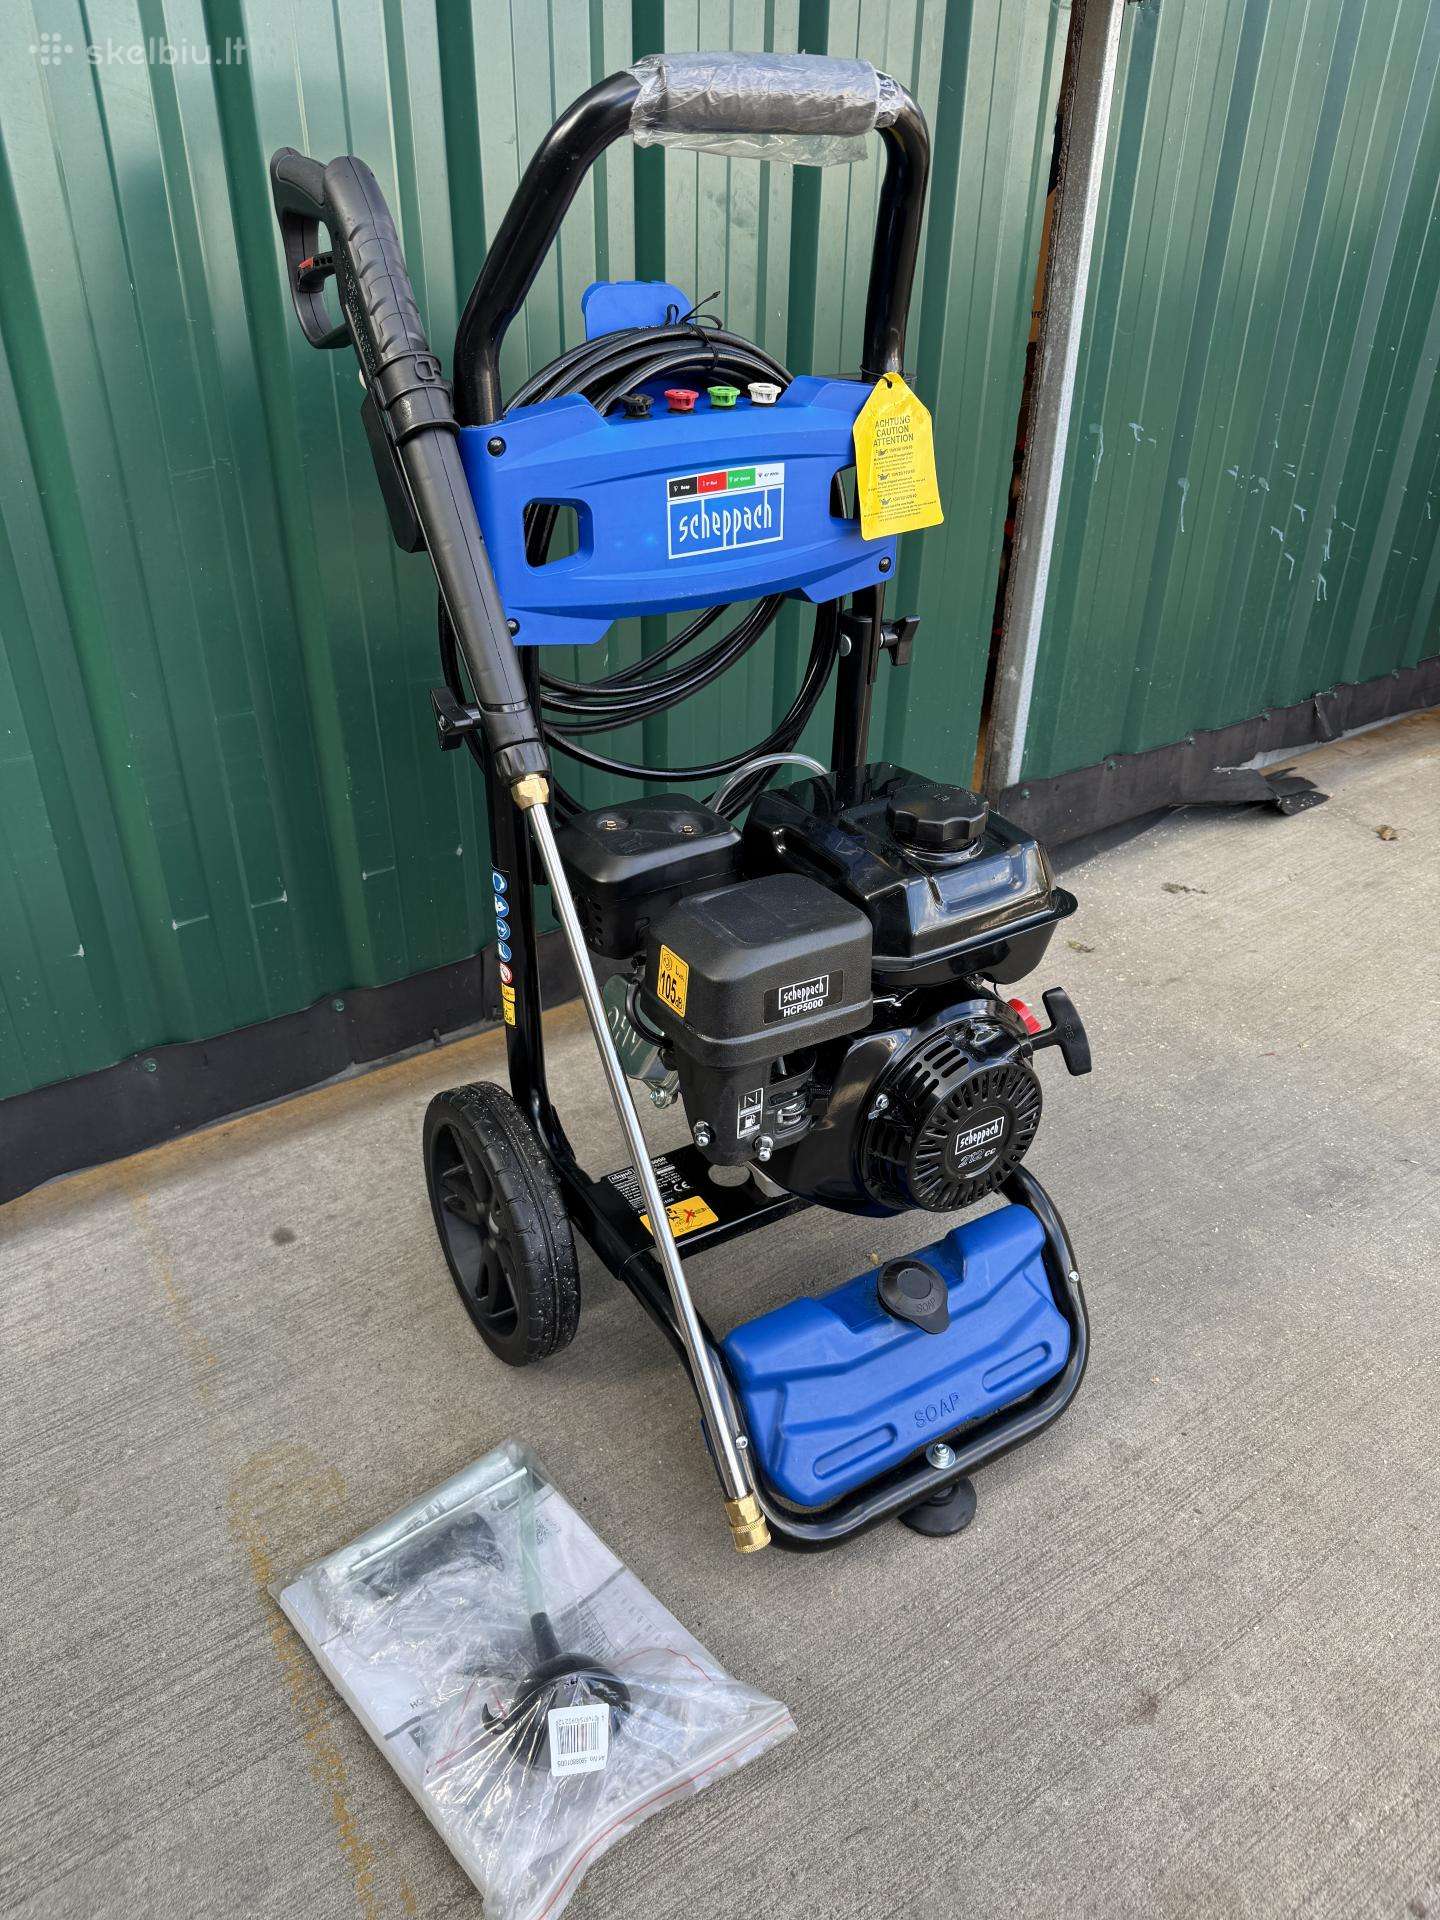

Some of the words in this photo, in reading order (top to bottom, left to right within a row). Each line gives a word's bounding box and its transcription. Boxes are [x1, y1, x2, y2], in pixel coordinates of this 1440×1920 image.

[875, 416, 911, 429] ACHTUNG
[876, 425, 909, 438] CAUTION
[873, 433, 914, 447] ATTENTION
[679, 488, 772, 549] scheppach
[661, 970, 677, 1003] 105
[783, 978, 824, 1003] scheppach
[783, 999, 824, 1017] HCP5000
[960, 1119, 999, 1148] scheppach
[916, 1296, 936, 1314] SOAP
[914, 1391, 960, 1428] SOAP
